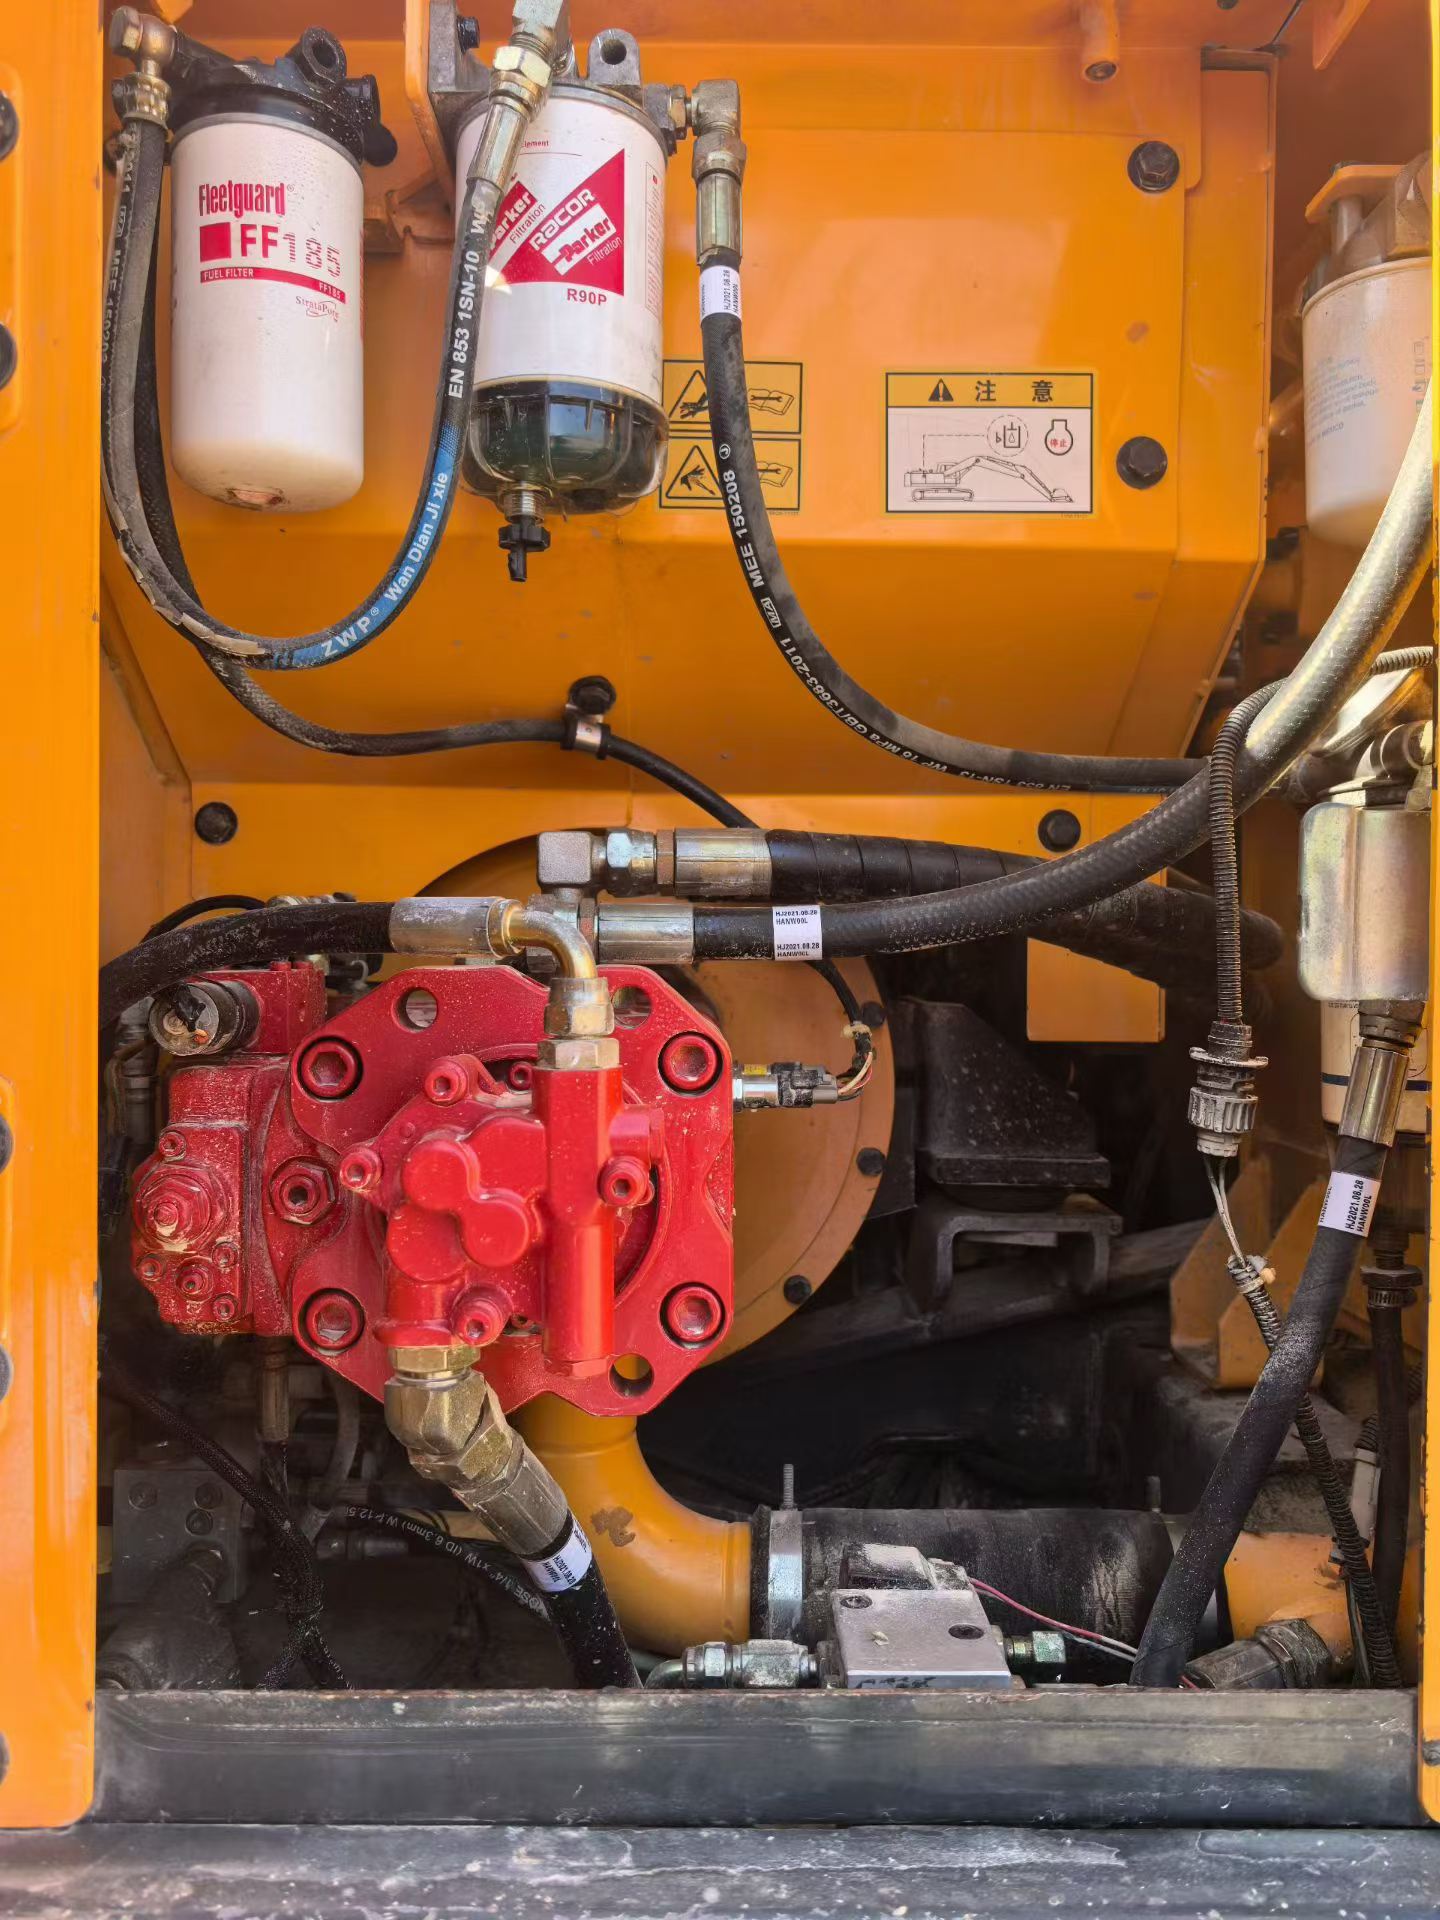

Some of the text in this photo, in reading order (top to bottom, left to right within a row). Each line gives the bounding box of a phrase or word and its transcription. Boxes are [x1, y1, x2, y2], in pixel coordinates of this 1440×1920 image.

[509, 203, 547, 245] Filtration
[555, 217, 612, 264] Parker
[587, 236, 623, 266] Filtration
[204, 268, 254, 281] FUEL FILTER
[318, 281, 341, 299] FF185
[457, 250, 480, 320] 1SN-10
[567, 288, 608, 306] R90P
[452, 327, 470, 365] 853
[449, 368, 465, 400] EN
[975, 379, 1053, 402] 注意
[432, 472, 449, 500] xie
[425, 501, 441, 520] Ji
[722, 469, 748, 539] 150208
[407, 523, 434, 564] Dian
[740, 542, 764, 588] MEE
[384, 565, 415, 602] Wan
[869, 733, 900, 754] MPa
[1345, 1179, 1364, 1230] HJ2021.08.28
